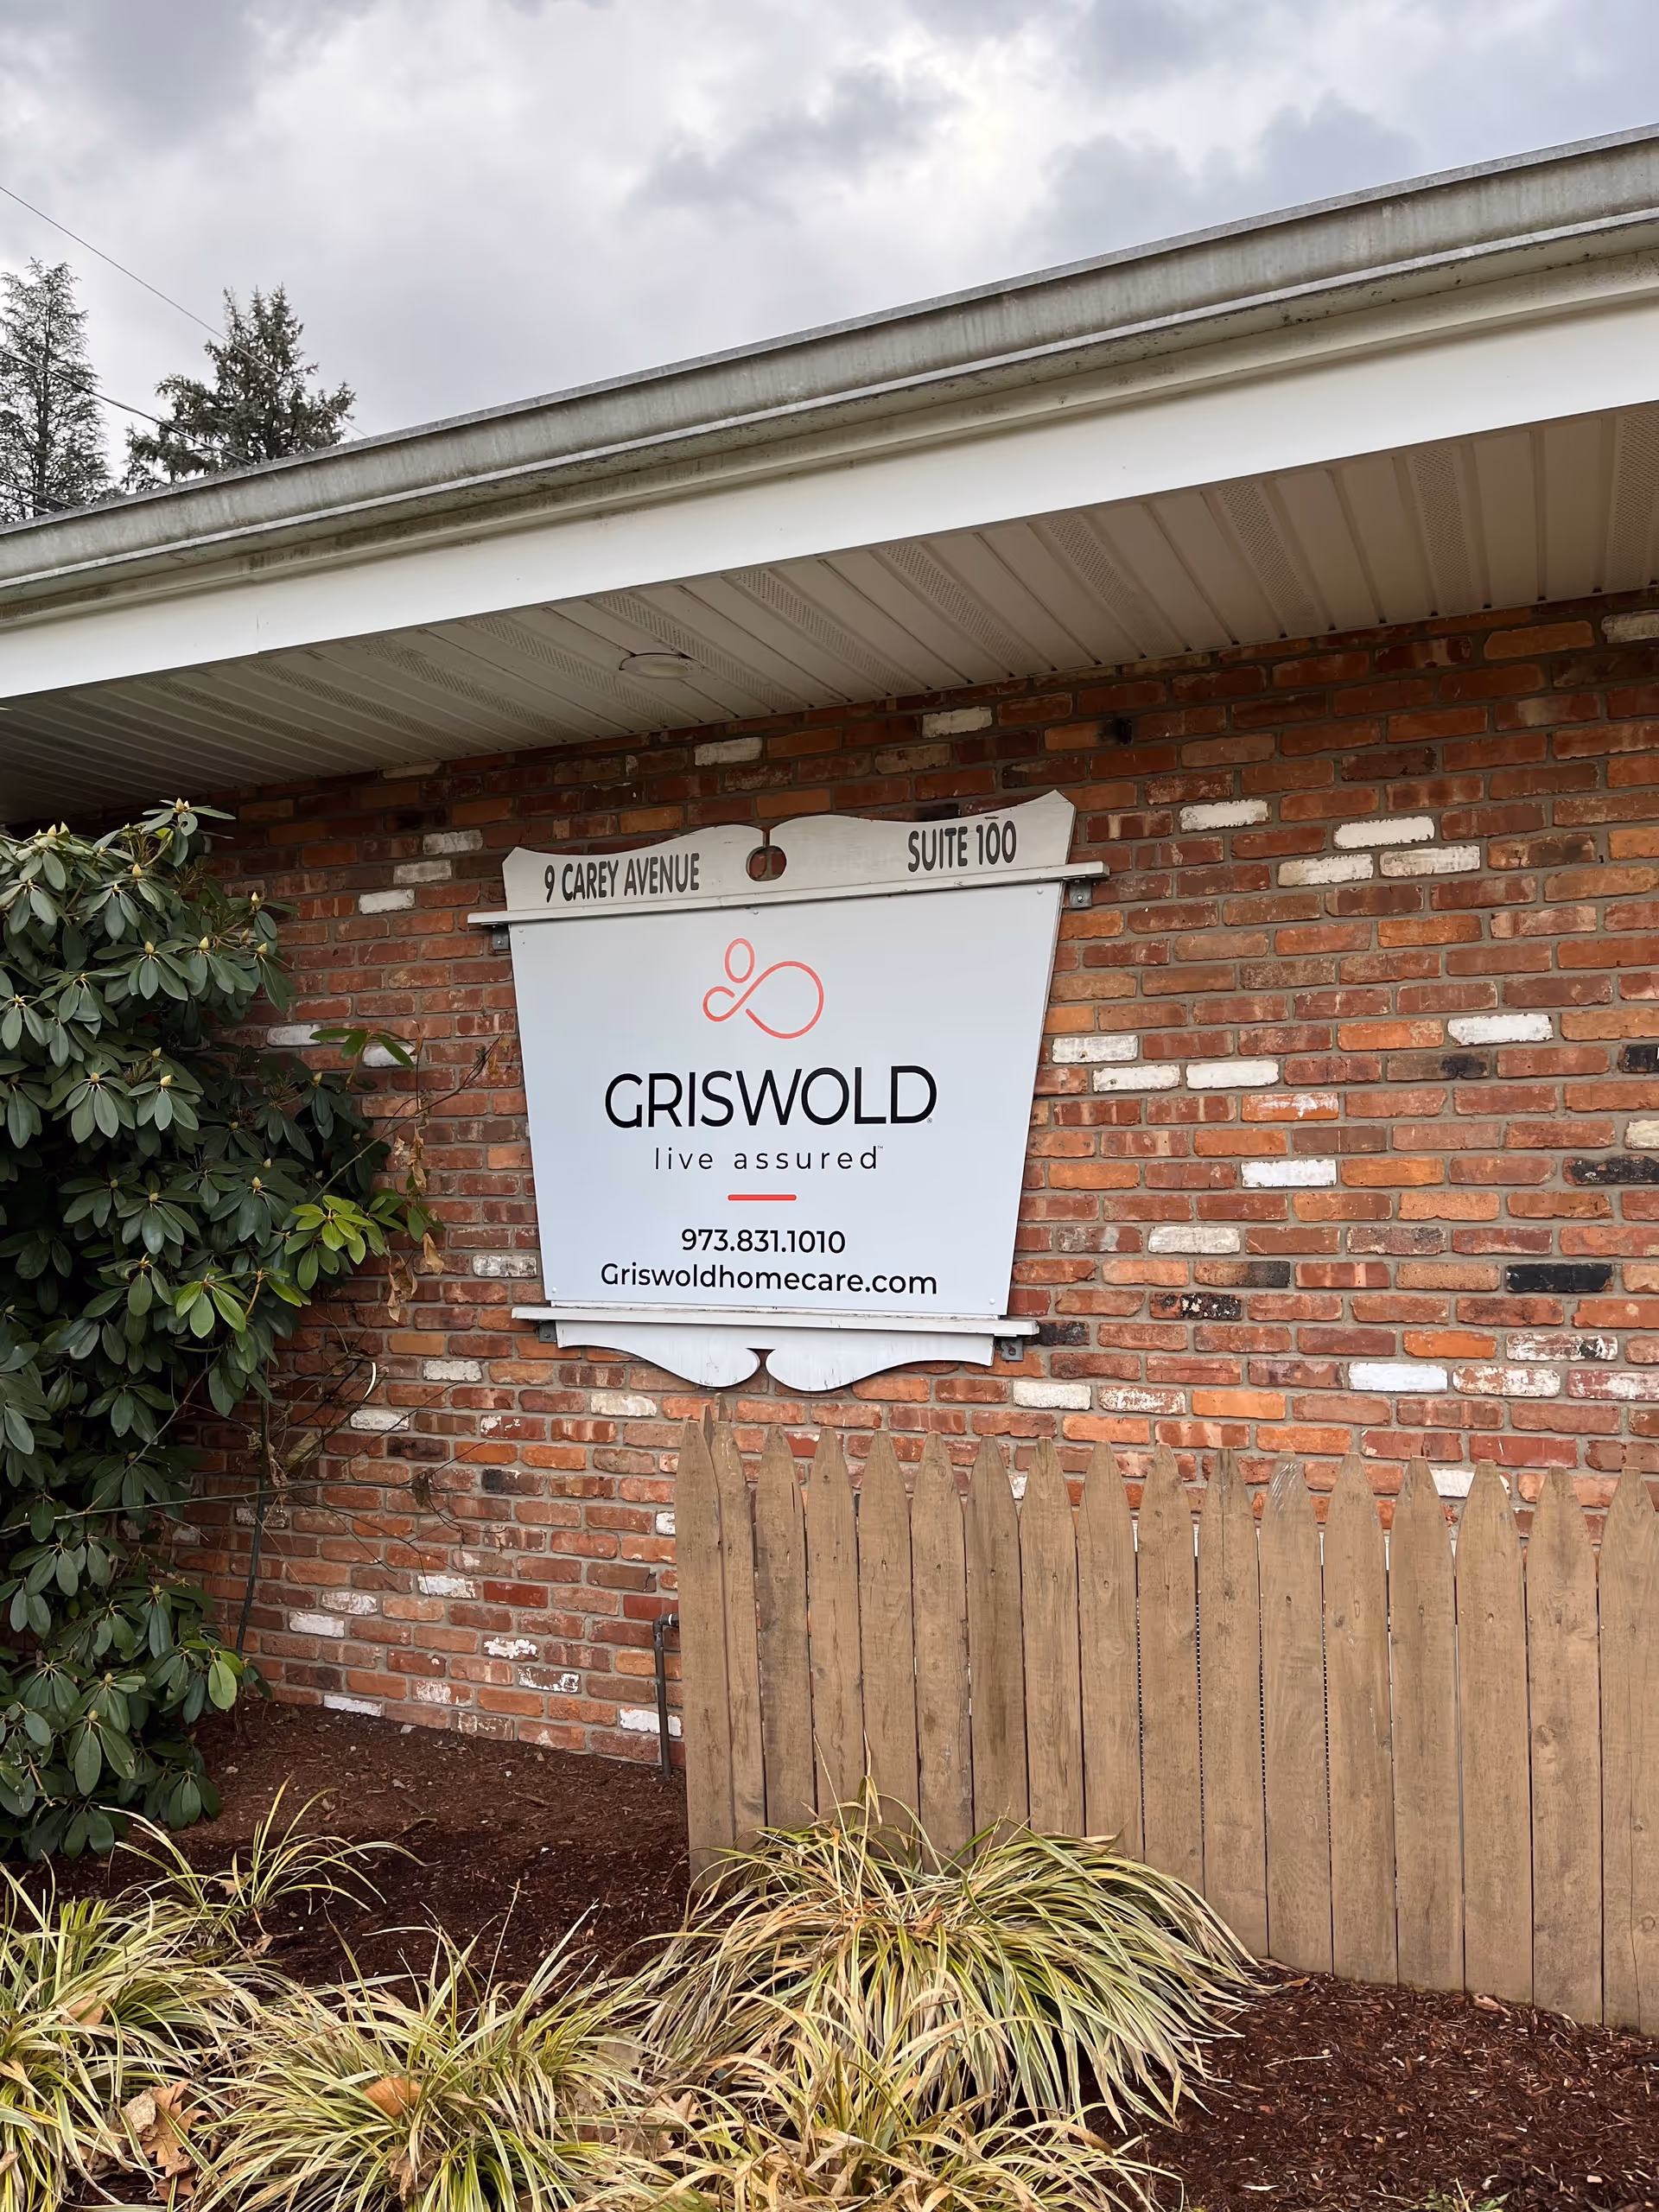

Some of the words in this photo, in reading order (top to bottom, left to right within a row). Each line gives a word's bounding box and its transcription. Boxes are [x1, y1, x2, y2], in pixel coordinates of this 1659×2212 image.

[907, 827, 969, 873] SUITE
[976, 820, 1017, 867] 100
[544, 865, 556, 903] 9
[562, 860, 620, 902] CAREY
[623, 853, 700, 897] AVENUE
[655, 1147, 713, 1170] live
[681, 1228, 846, 1254] 973.831.1010
[601, 1262, 938, 1294] Griswoldhomecare.com
